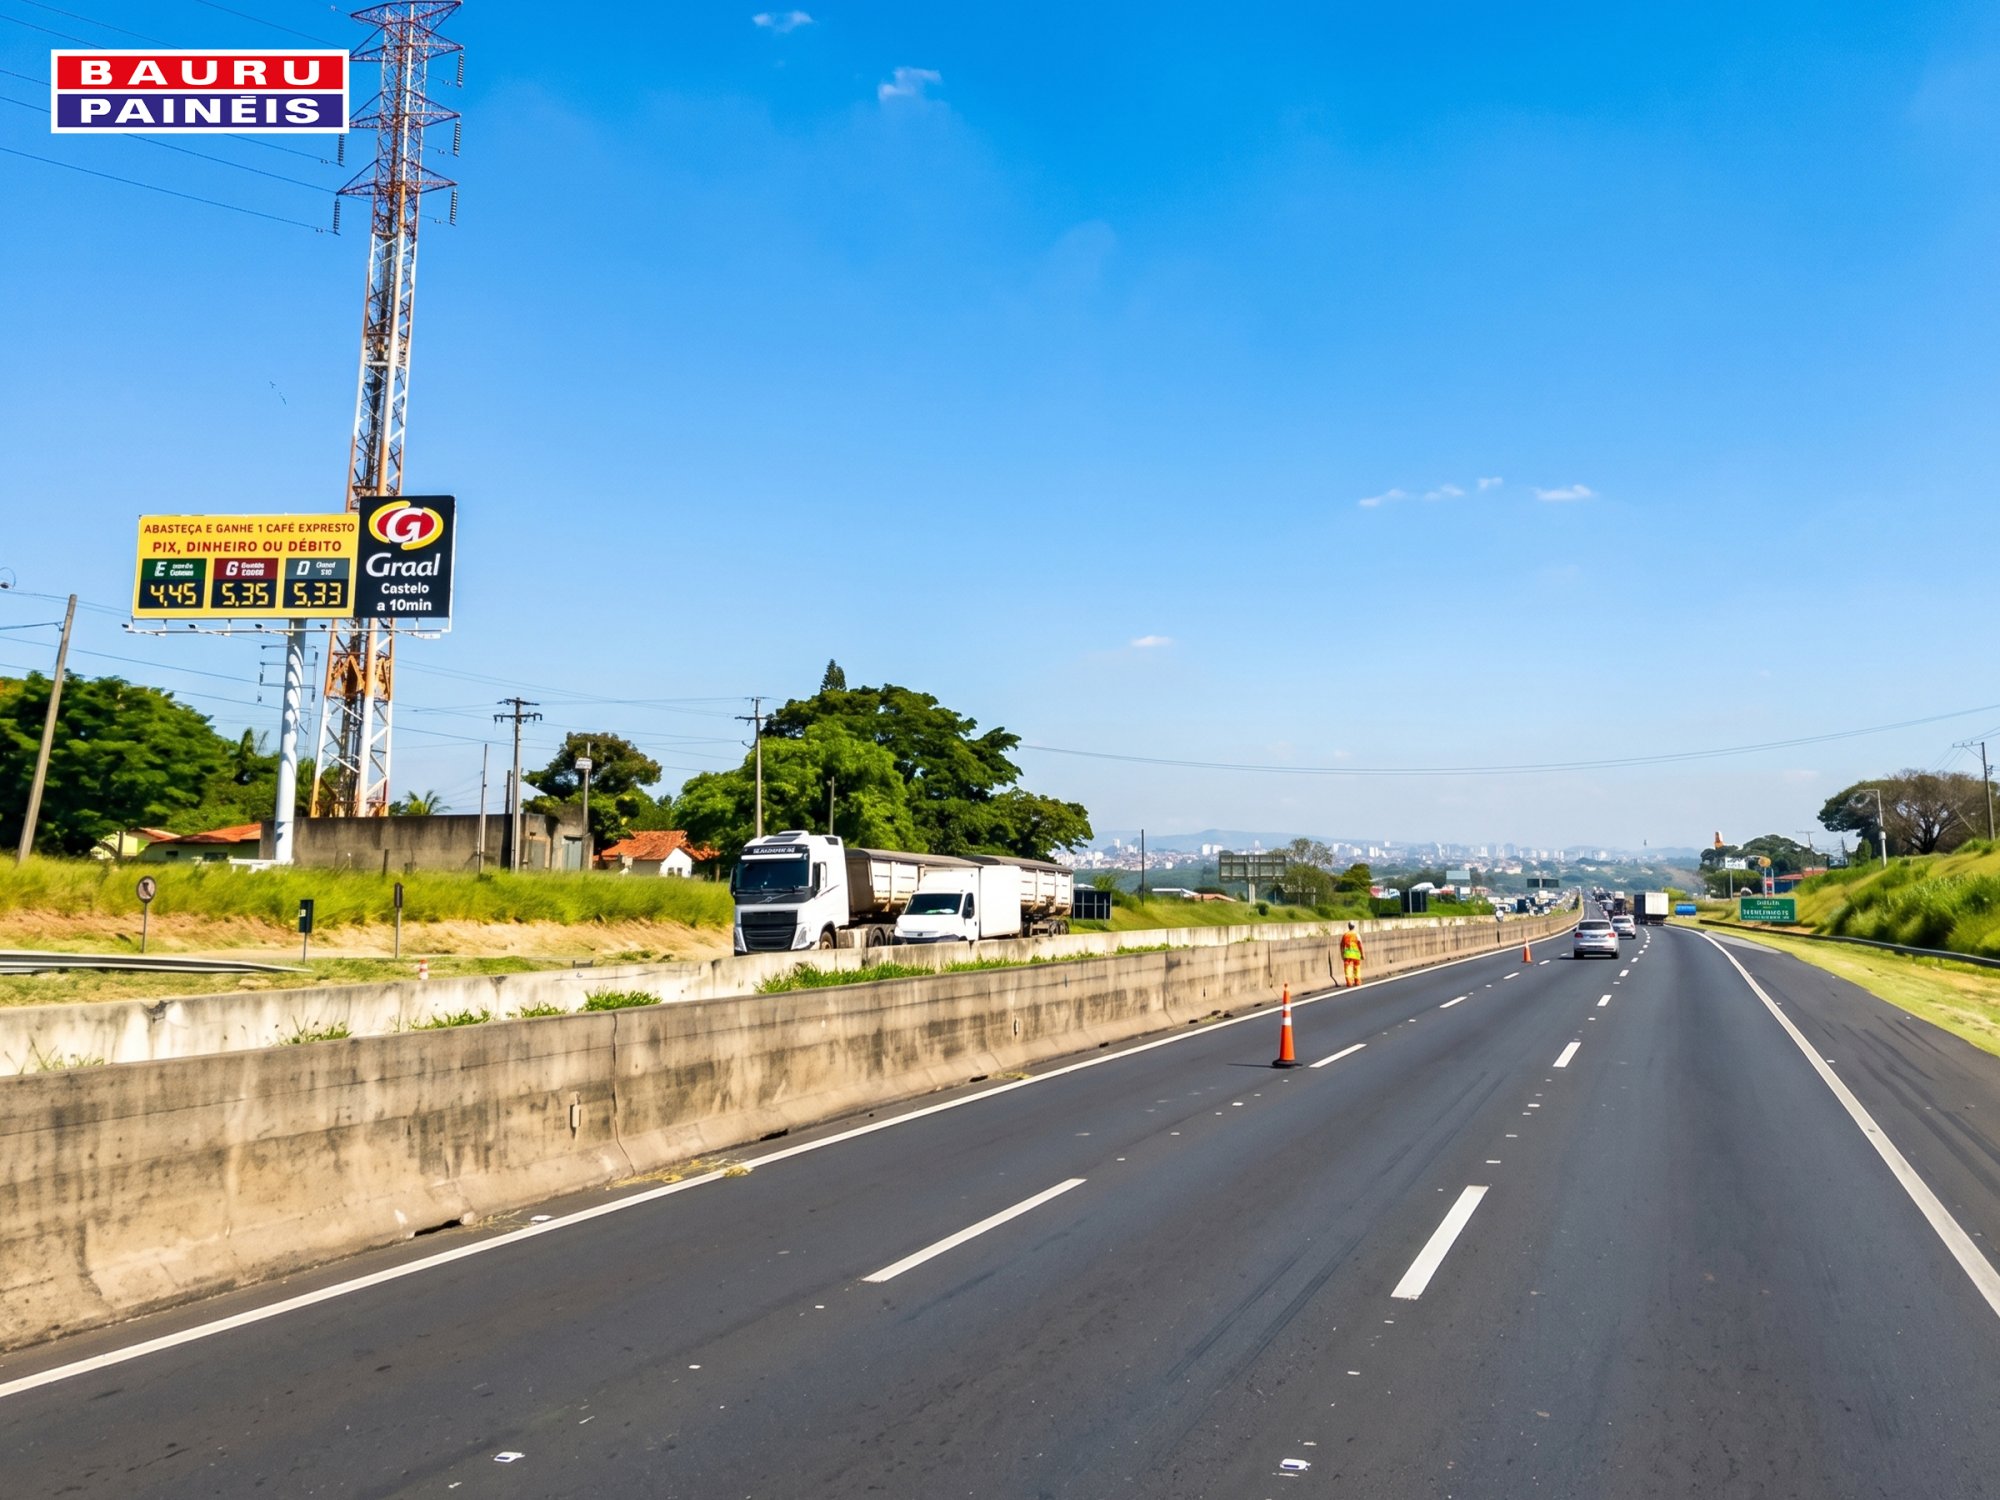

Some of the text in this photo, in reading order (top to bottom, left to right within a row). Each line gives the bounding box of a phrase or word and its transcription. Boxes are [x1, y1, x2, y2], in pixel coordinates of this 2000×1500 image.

[144, 522, 355, 535] ABASTEÇA E GANHE 1 CAFÉ EXPRESTO
[153, 538, 342, 555] PIX, DINHEIRO OU DÉBITO
[154, 561, 167, 576] E
[226, 561, 239, 576] G
[296, 560, 310, 575] D
[366, 552, 441, 577] Graal
[150, 583, 197, 607] 4,45
[294, 582, 342, 607] 5,33
[381, 582, 429, 594] Castelo
[377, 598, 432, 611] a 10min
